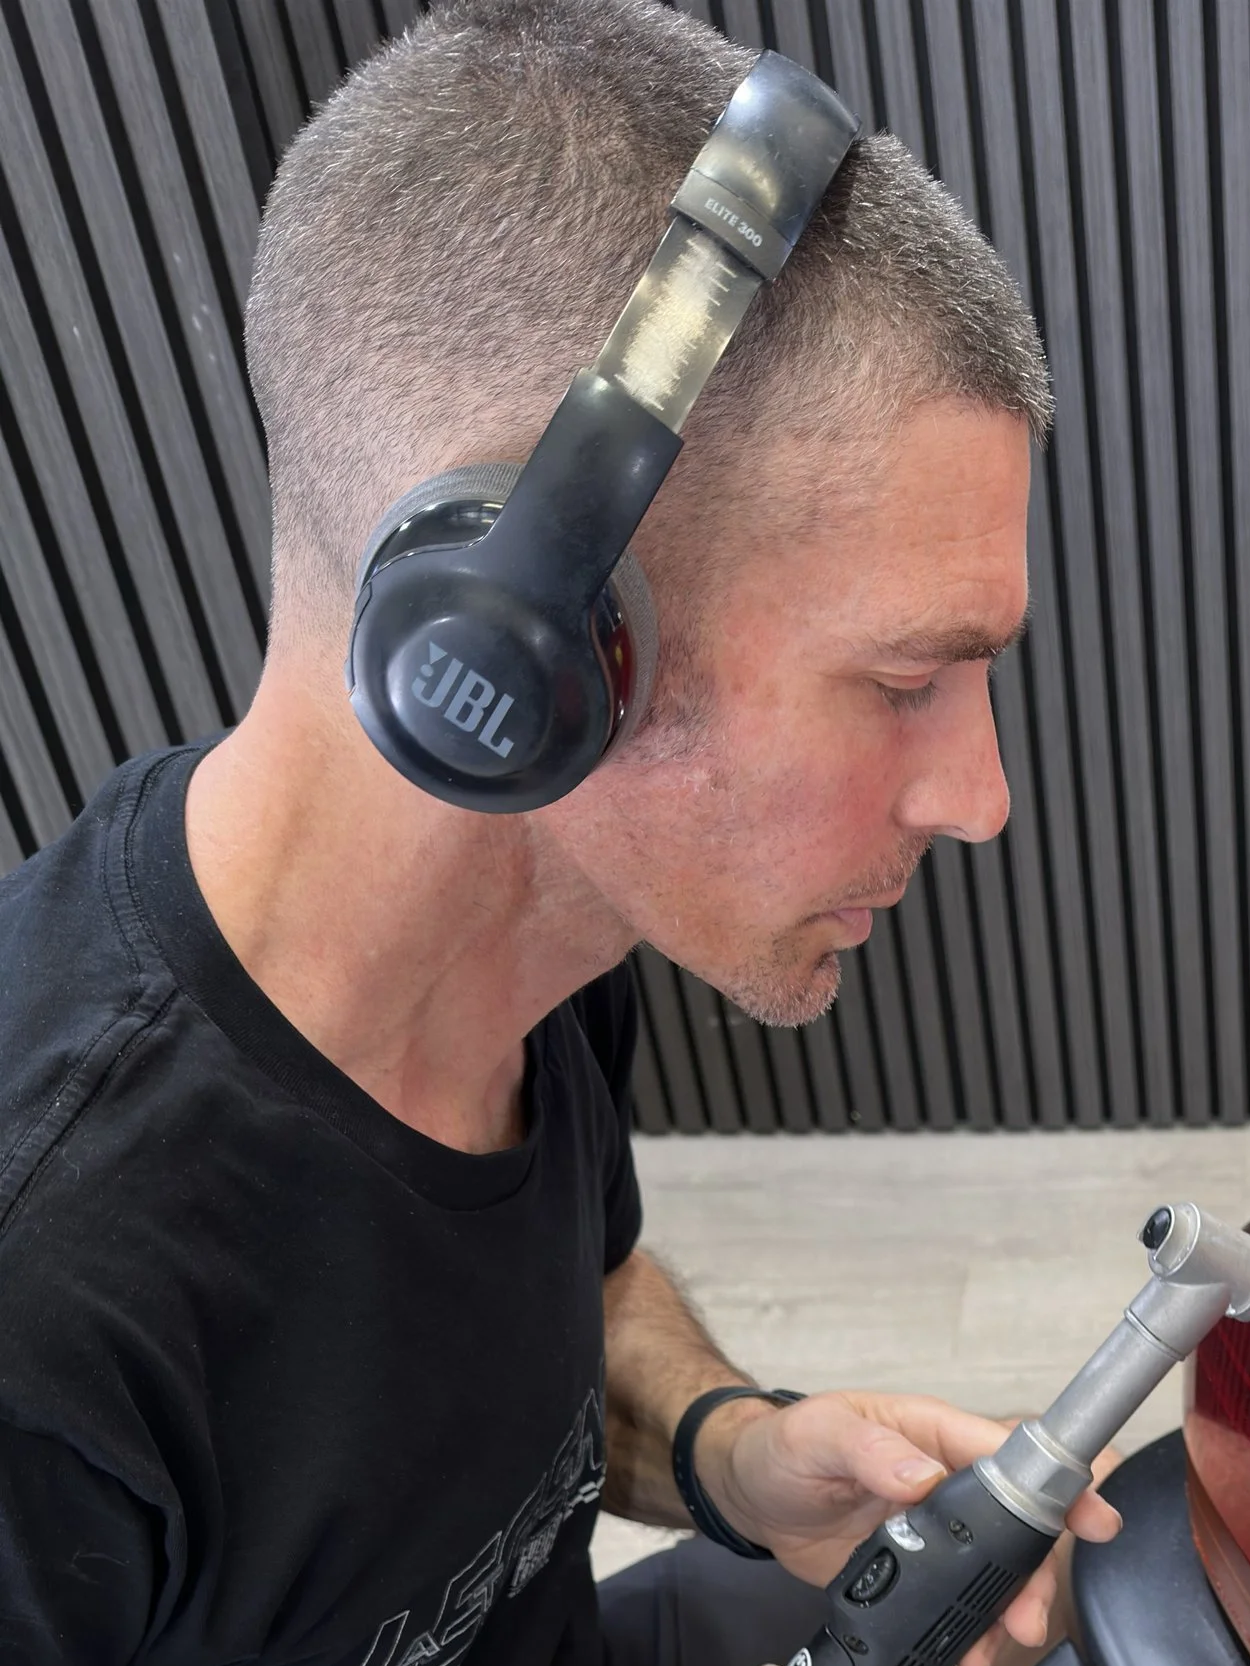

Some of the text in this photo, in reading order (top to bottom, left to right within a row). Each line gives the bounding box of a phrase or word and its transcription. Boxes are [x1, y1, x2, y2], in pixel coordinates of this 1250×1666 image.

[704, 198, 763, 247] ELITE 300
[411, 655, 515, 758] JBL
